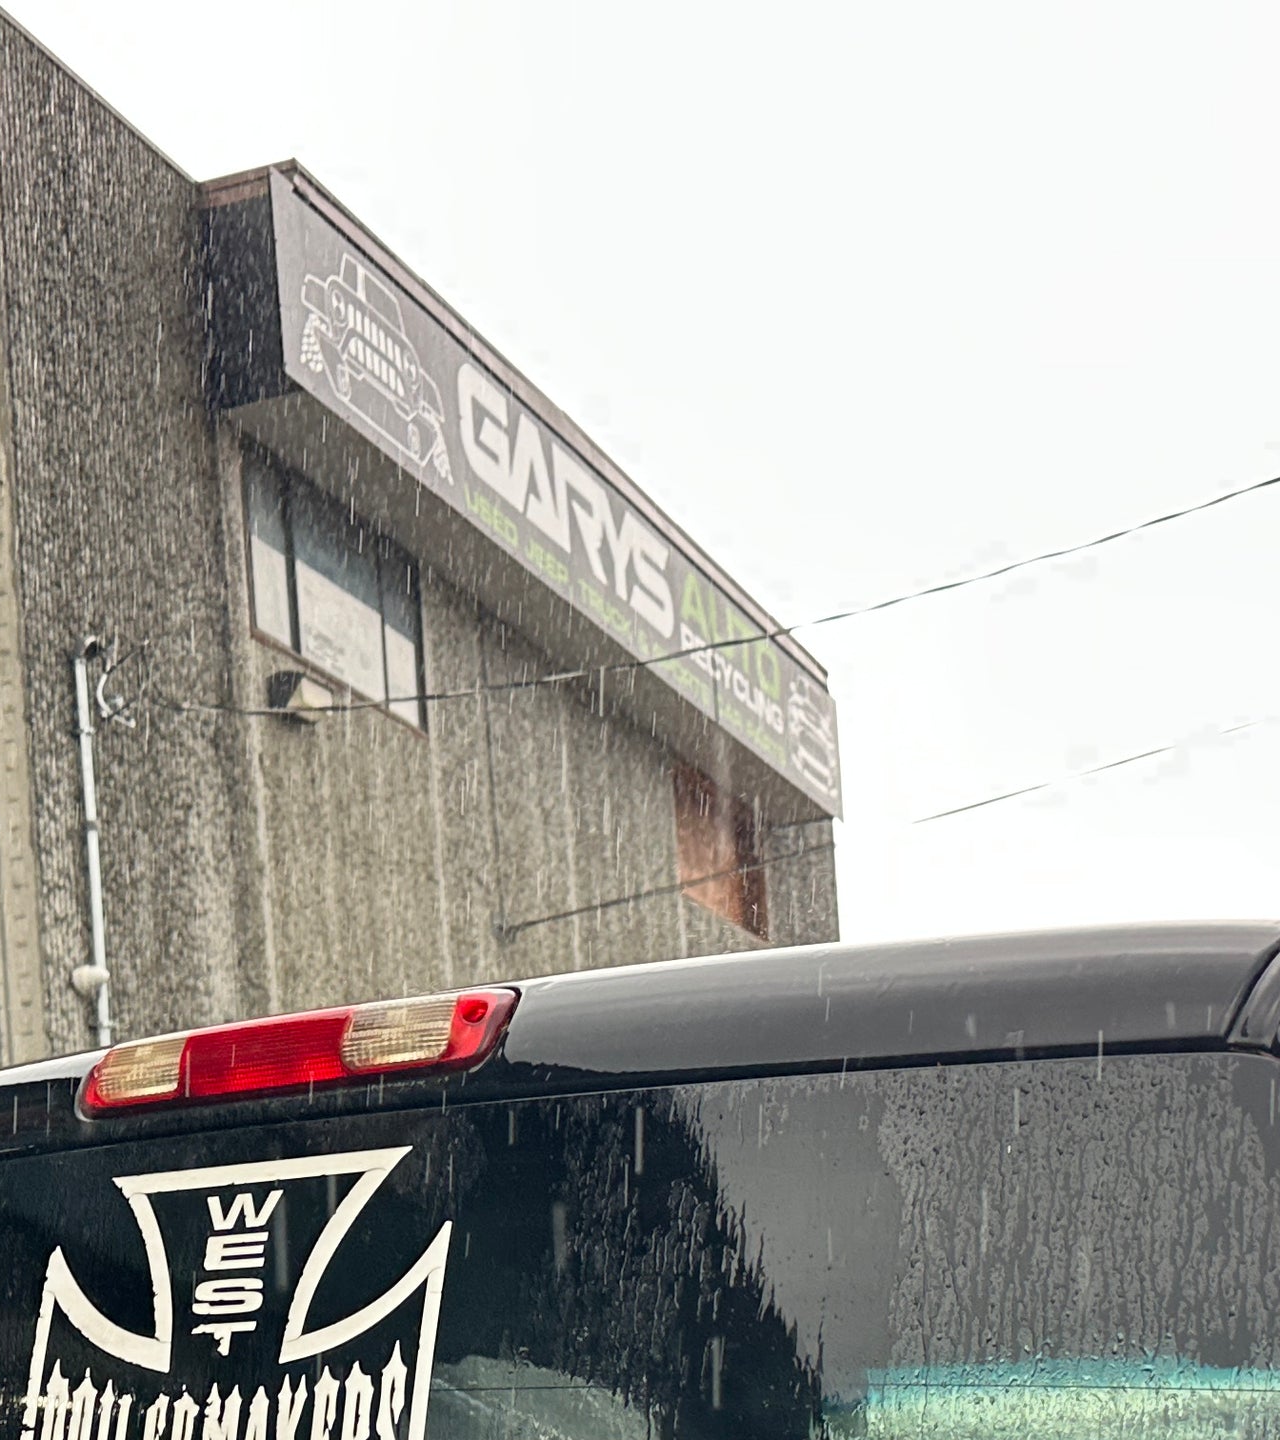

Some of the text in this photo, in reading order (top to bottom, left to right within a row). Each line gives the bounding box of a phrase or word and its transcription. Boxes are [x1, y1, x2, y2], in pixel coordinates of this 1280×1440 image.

[457, 363, 673, 638] GARYS
[680, 571, 781, 700] AUTO
[680, 621, 785, 735] RECYCLING
[191, 1190, 283, 1356] WEST
